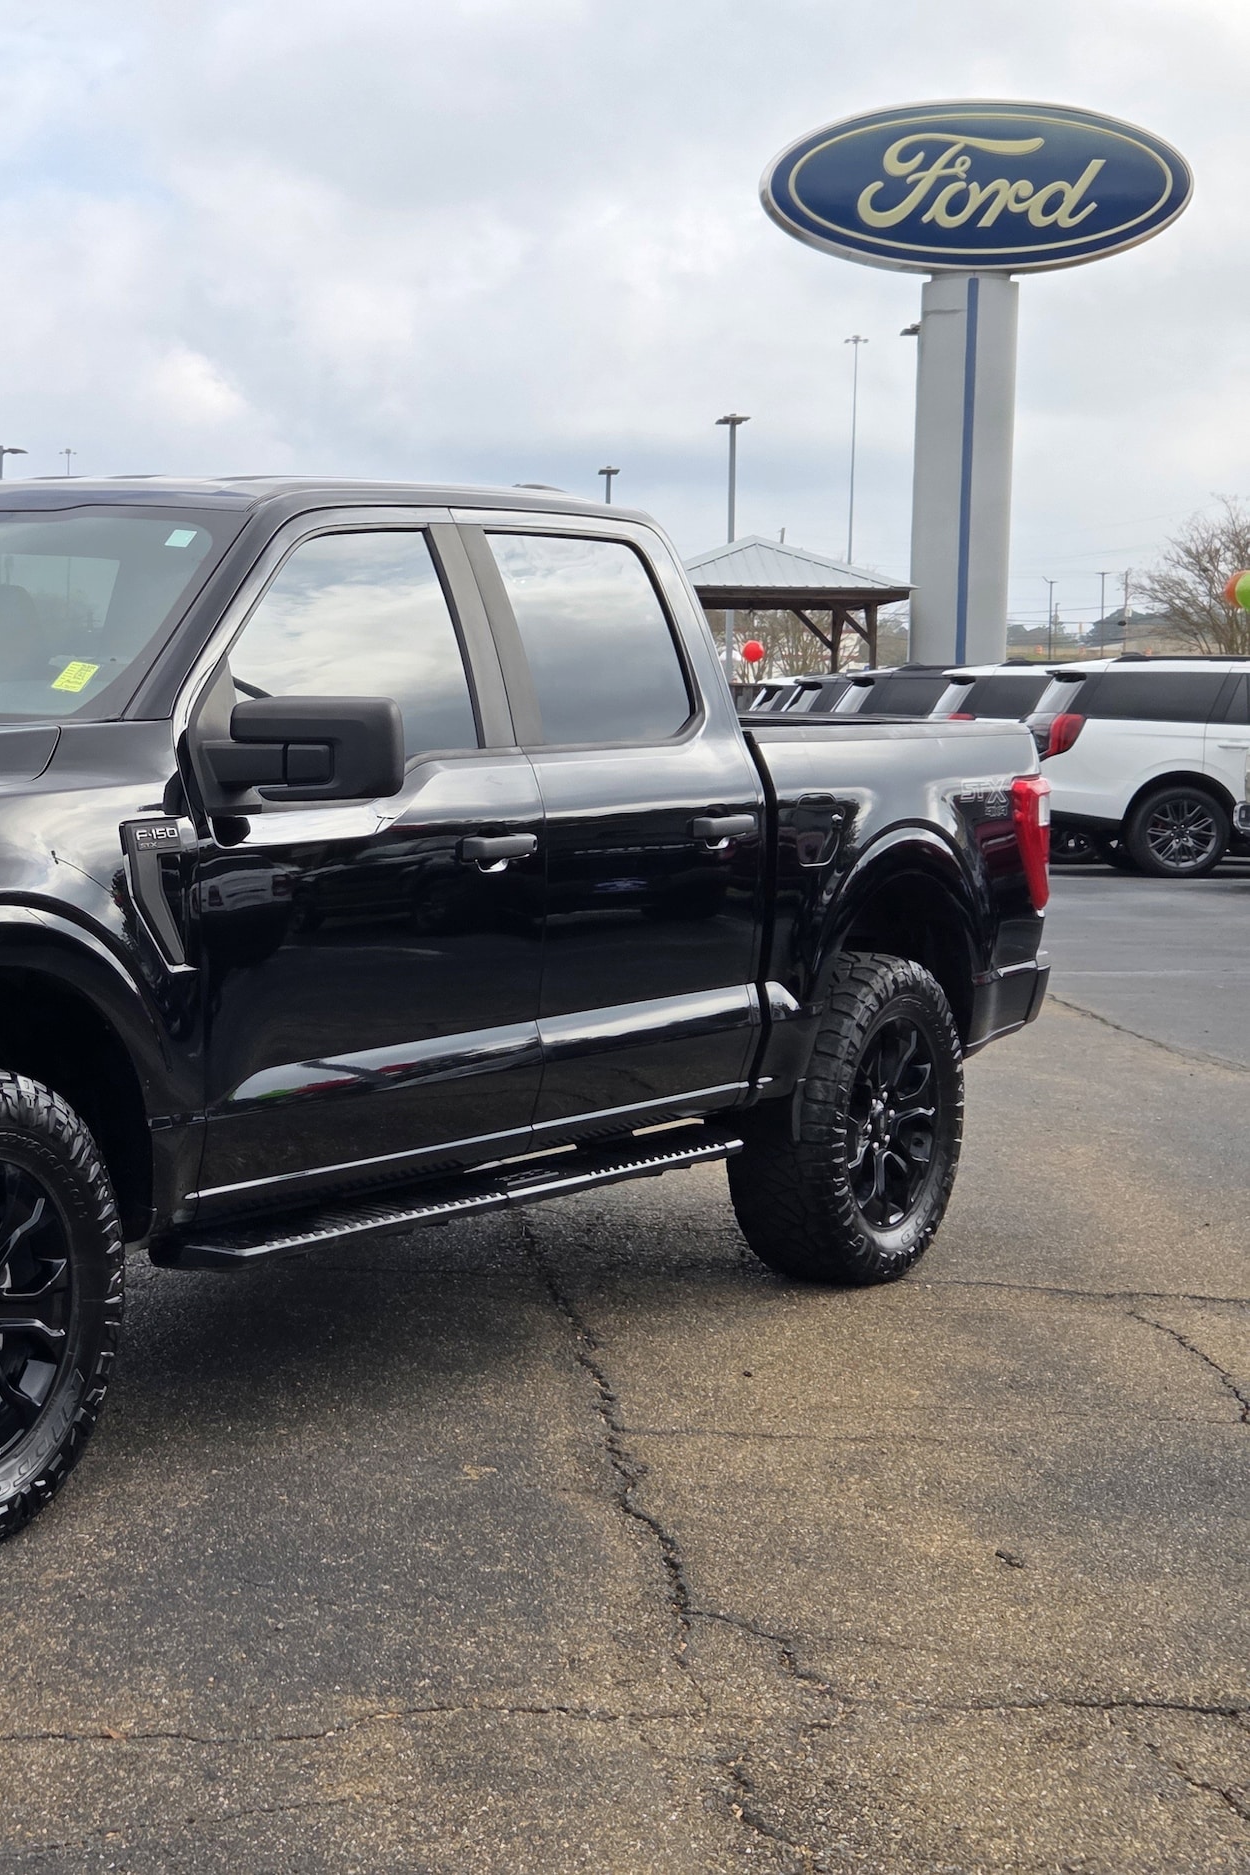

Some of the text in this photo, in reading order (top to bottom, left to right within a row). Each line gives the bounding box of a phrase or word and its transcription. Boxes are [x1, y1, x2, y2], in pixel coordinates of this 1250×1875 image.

[857, 132, 1107, 229] Ford
[960, 776, 1008, 804] STX
[136, 827, 178, 841] F-150
